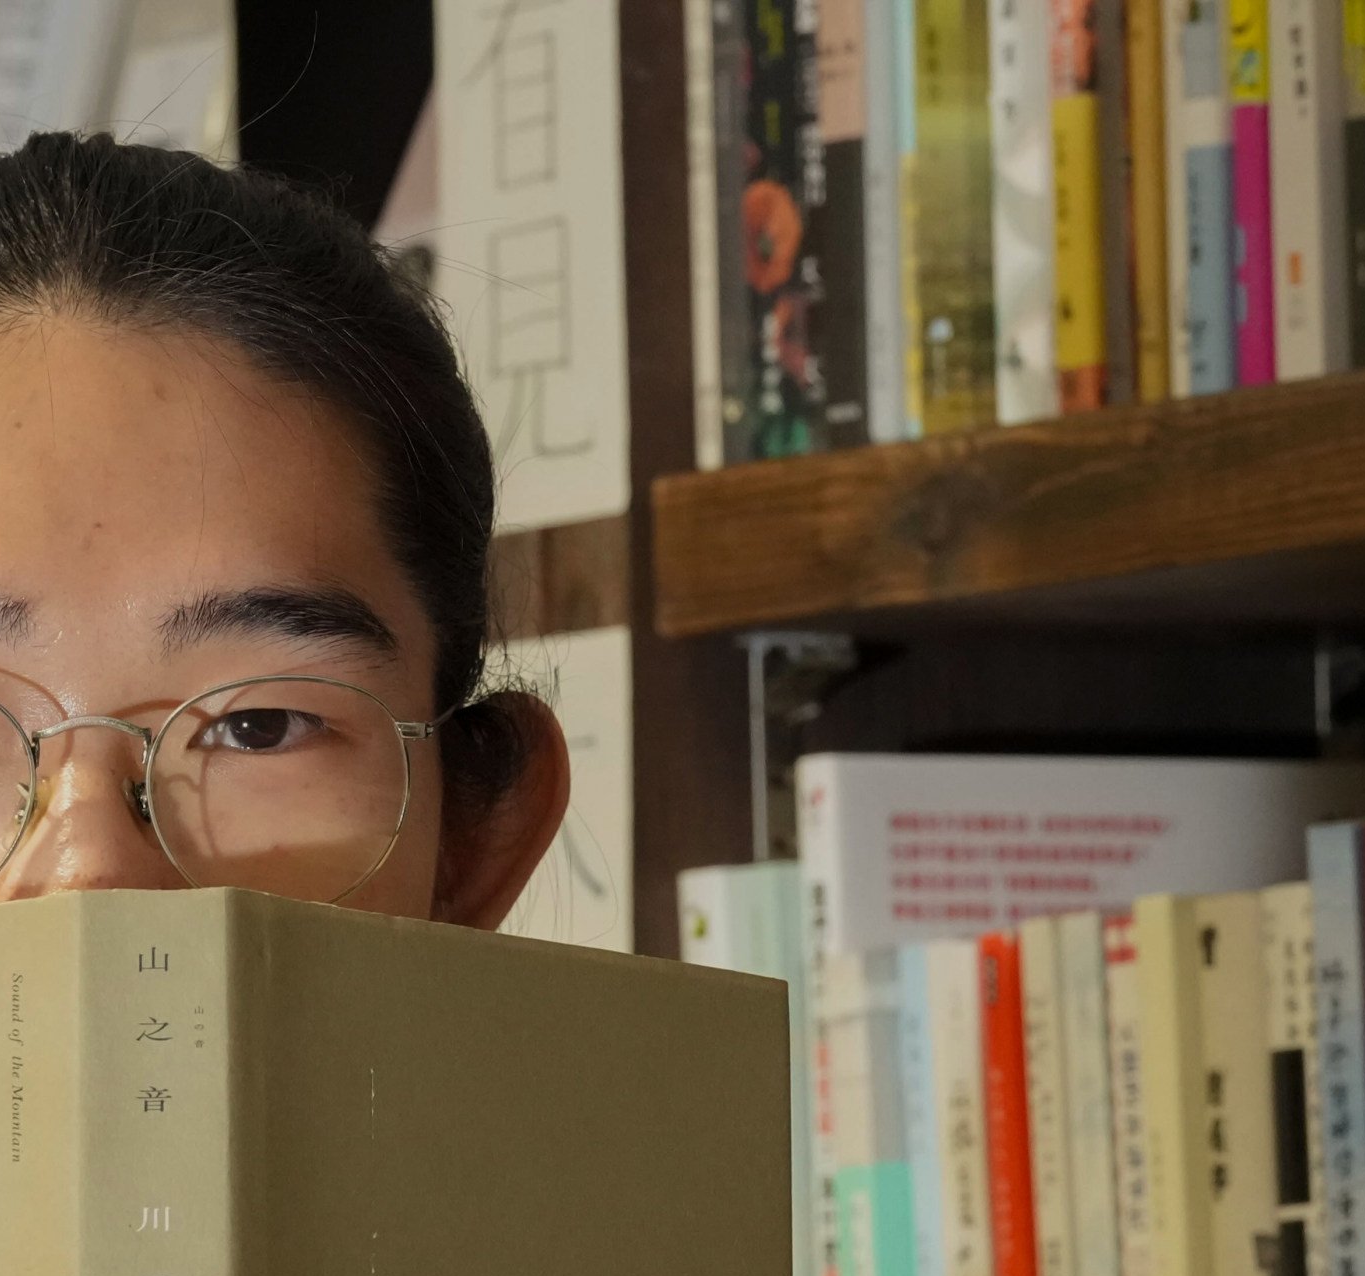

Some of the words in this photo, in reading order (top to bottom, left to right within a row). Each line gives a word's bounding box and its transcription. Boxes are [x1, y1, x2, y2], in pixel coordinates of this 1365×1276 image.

[11, 972, 25, 1023] Sound
[8, 1025, 25, 1047] of
[136, 946, 173, 1114] 山之音
[194, 1005, 204, 1049] 山の音
[11, 1056, 24, 1079] the
[11, 1082, 25, 1164] Mountain
